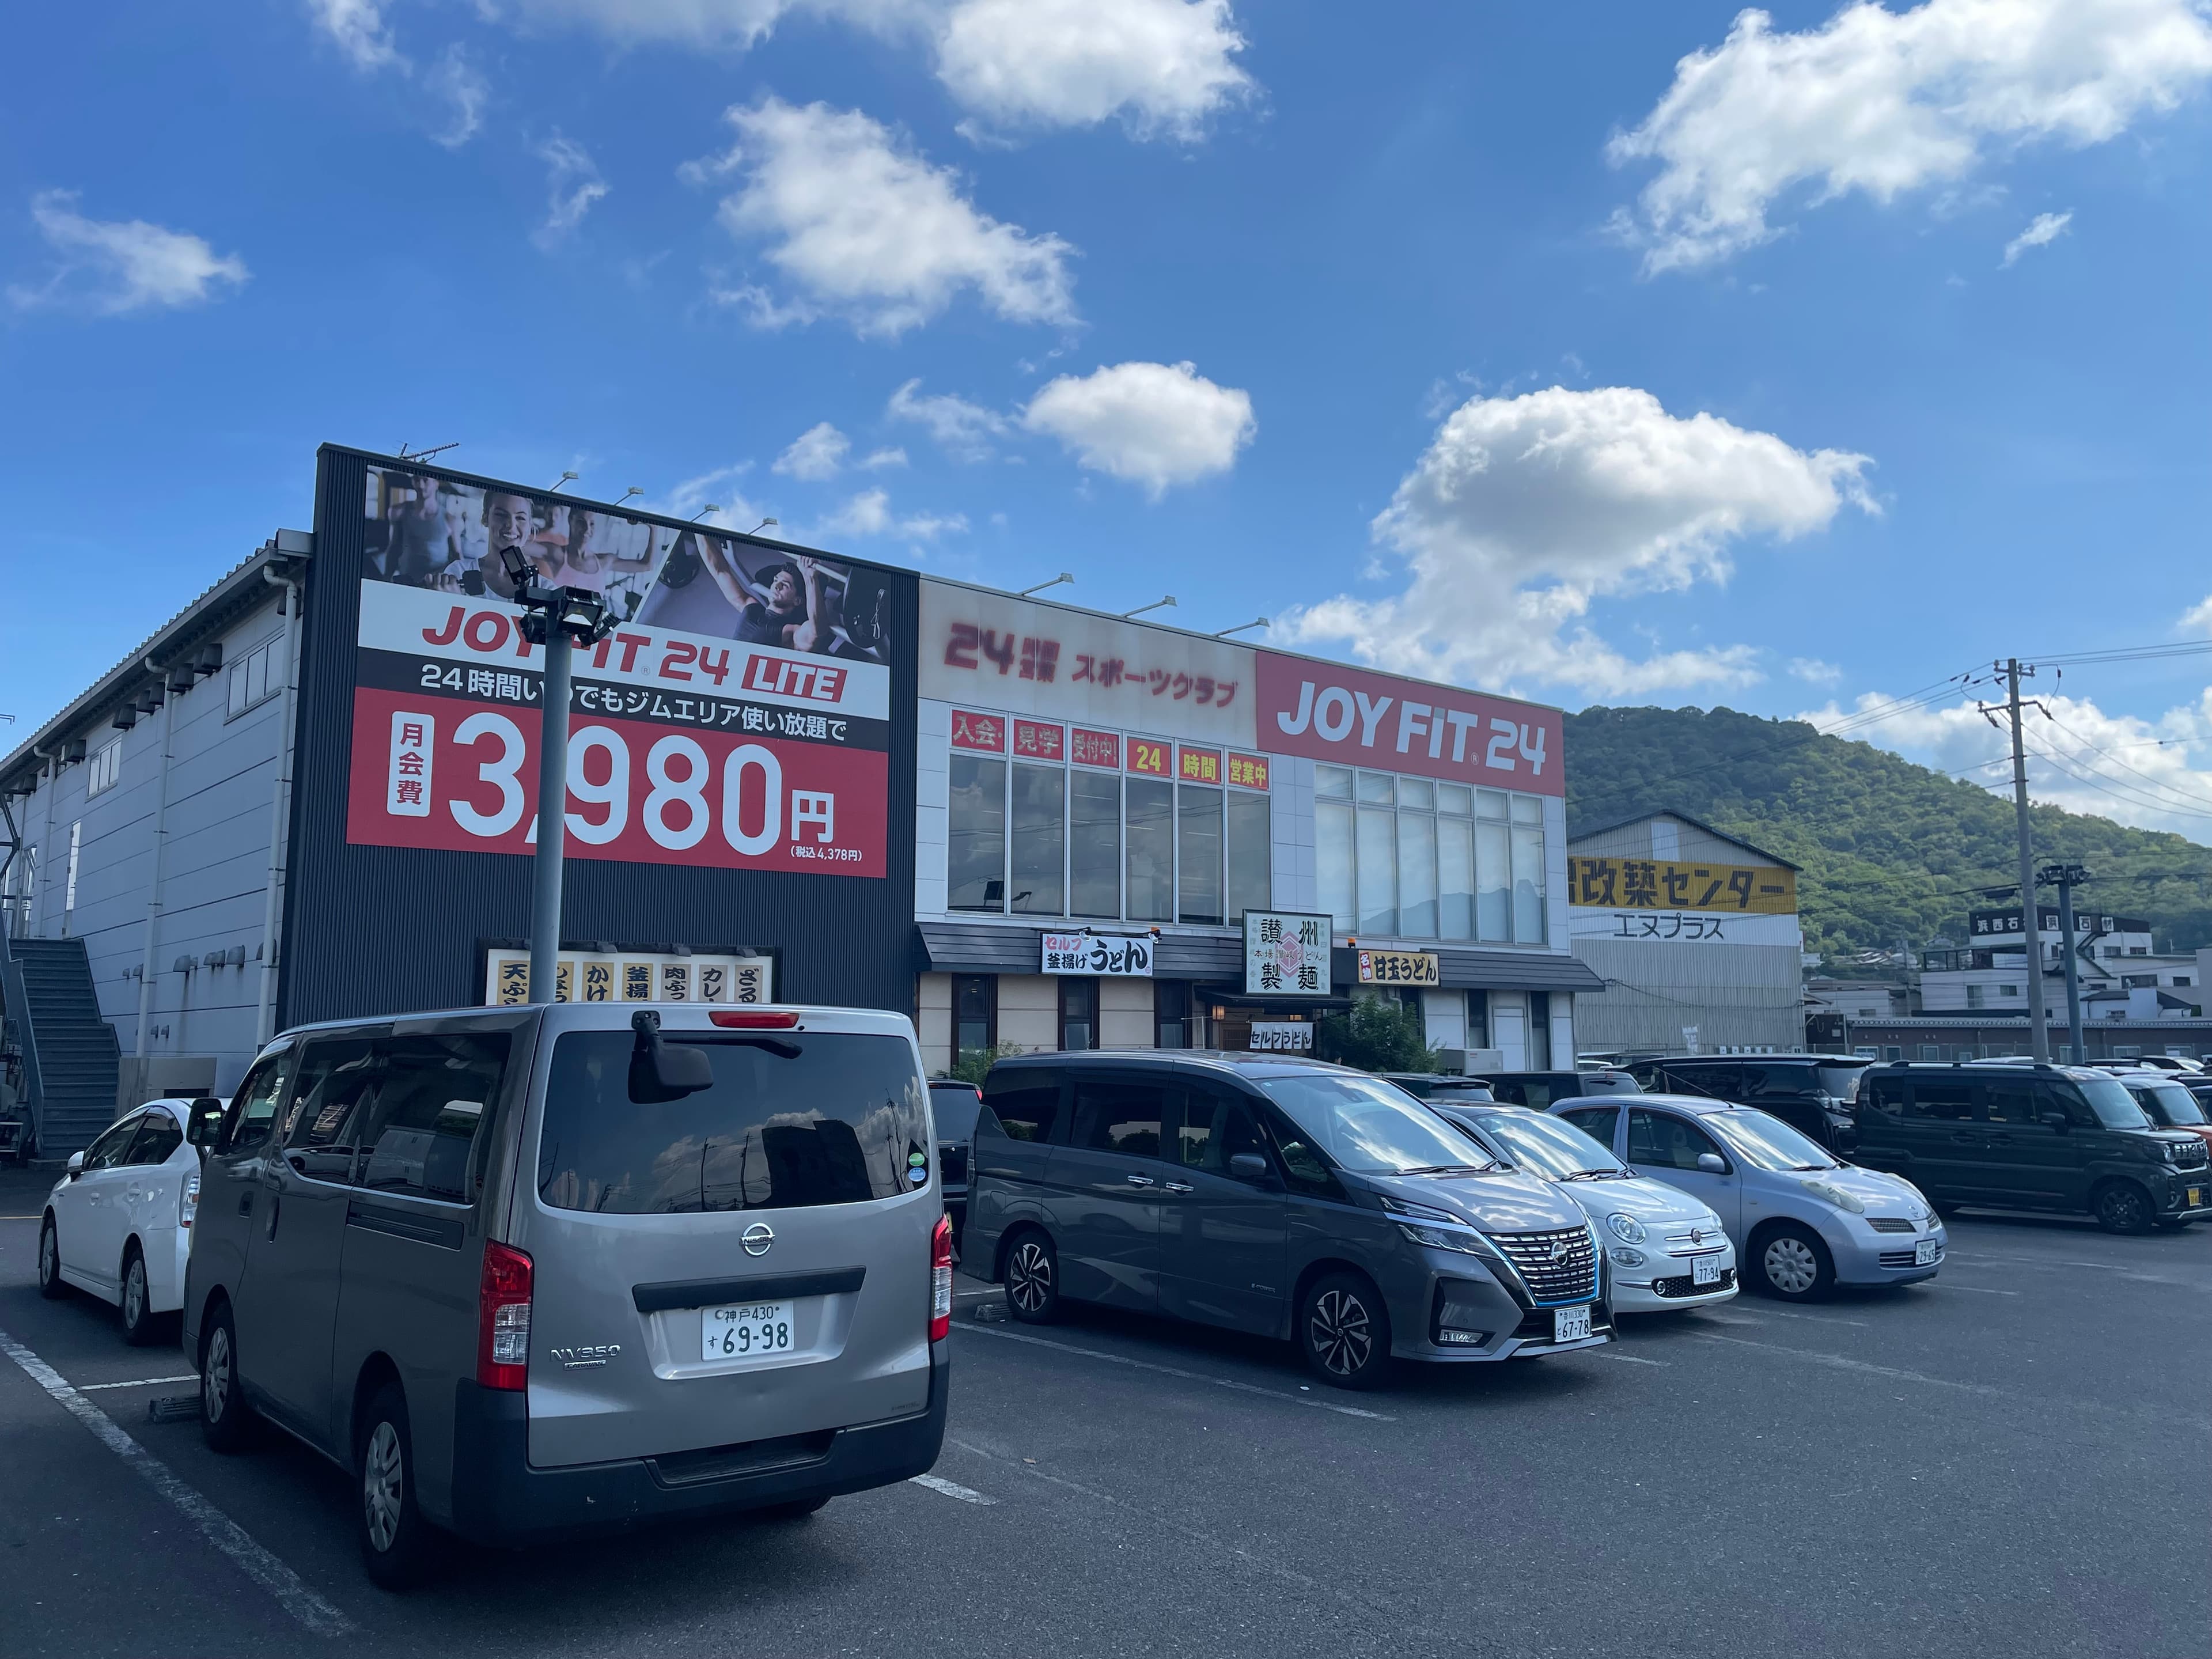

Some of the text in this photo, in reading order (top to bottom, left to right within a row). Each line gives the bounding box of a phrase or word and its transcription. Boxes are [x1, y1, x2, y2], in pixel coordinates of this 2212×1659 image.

[944, 623, 1015, 676] 24
[659, 641, 729, 685] 24
[750, 657, 841, 701] LITE
[1072, 654, 1238, 708] スポーツクラブ
[421, 664, 846, 741] 24時間いでもジムエリア使い放題で
[1018, 725, 1059, 755] 見学
[1137, 745, 1162, 772] 24
[1183, 753, 1217, 781] 時間
[1230, 758, 1267, 787] 営業中
[1486, 717, 1546, 776] 24
[396, 723, 424, 805] 月会費
[1614, 912, 1724, 940] エヌプラス
[1977, 916, 2025, 933] 浜西石
[1045, 935, 1082, 951] セルフ
[587, 965, 609, 1001] かけ
[626, 966, 649, 1001] 釜揚
[702, 968, 722, 1002] カレ
[1251, 1031, 1311, 1044] セルフうどん
[1699, 1267, 1719, 1282] 77-94
[707, 1322, 788, 1354] す 69-98
[1562, 1319, 1589, 1338] 67-78
[551, 1344, 620, 1361] NV350
